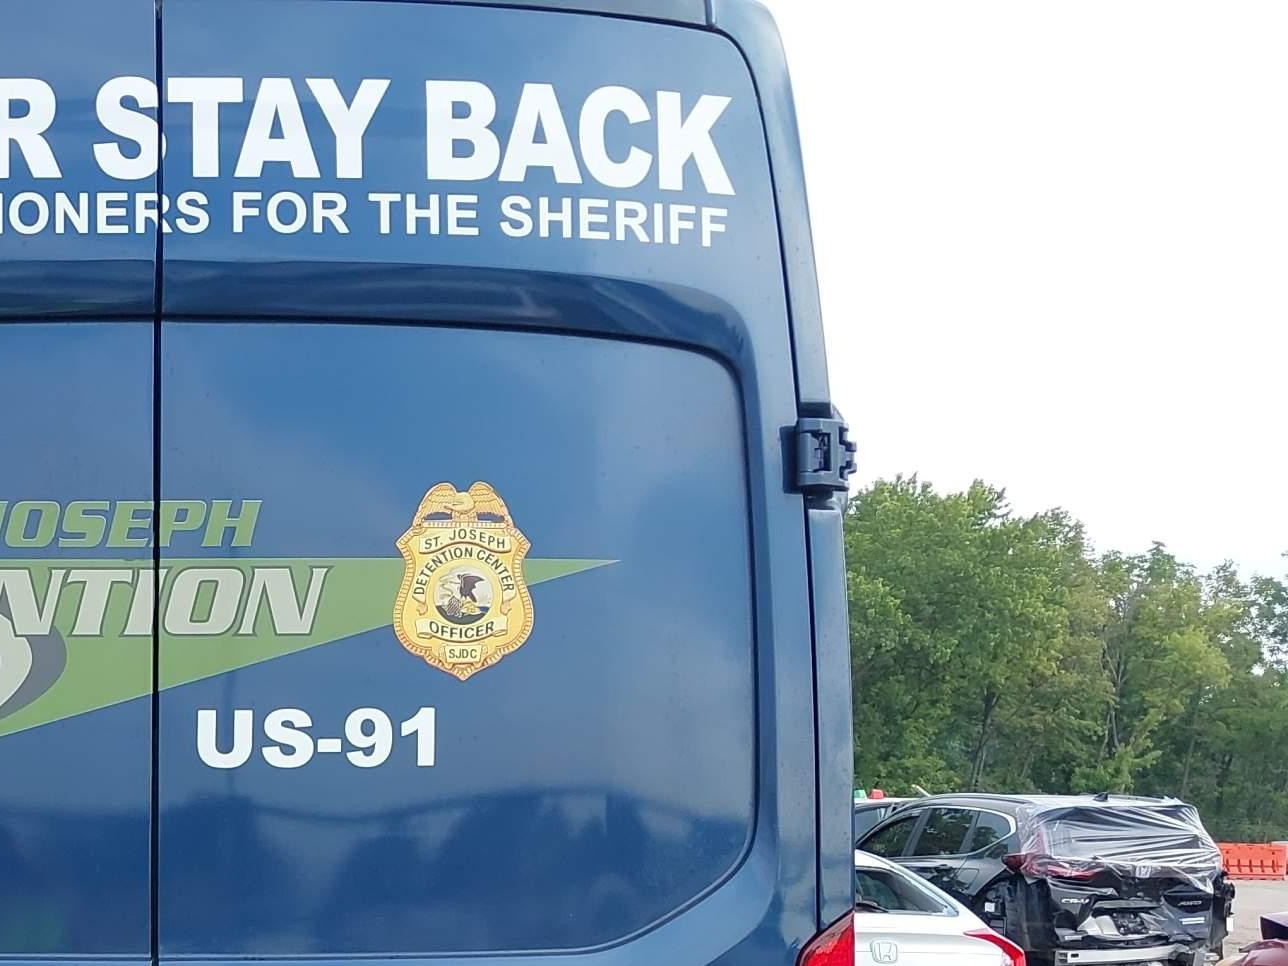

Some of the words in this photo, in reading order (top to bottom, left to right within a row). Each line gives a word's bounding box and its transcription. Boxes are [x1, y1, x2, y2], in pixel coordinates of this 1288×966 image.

[93, 75, 391, 181] STAY
[425, 80, 736, 196] BACK
[233, 191, 349, 234] FOR
[368, 193, 479, 236] THE
[499, 195, 728, 248] SHERIFF
[424, 537, 443, 550] ST.
[449, 529, 505, 549] JOSEPH
[414, 547, 473, 595] DETENTION
[477, 550, 514, 592] CENTER
[429, 620, 494, 639] OFFICER
[448, 648, 477, 659] SJDC
[196, 707, 436, 769] US-91
